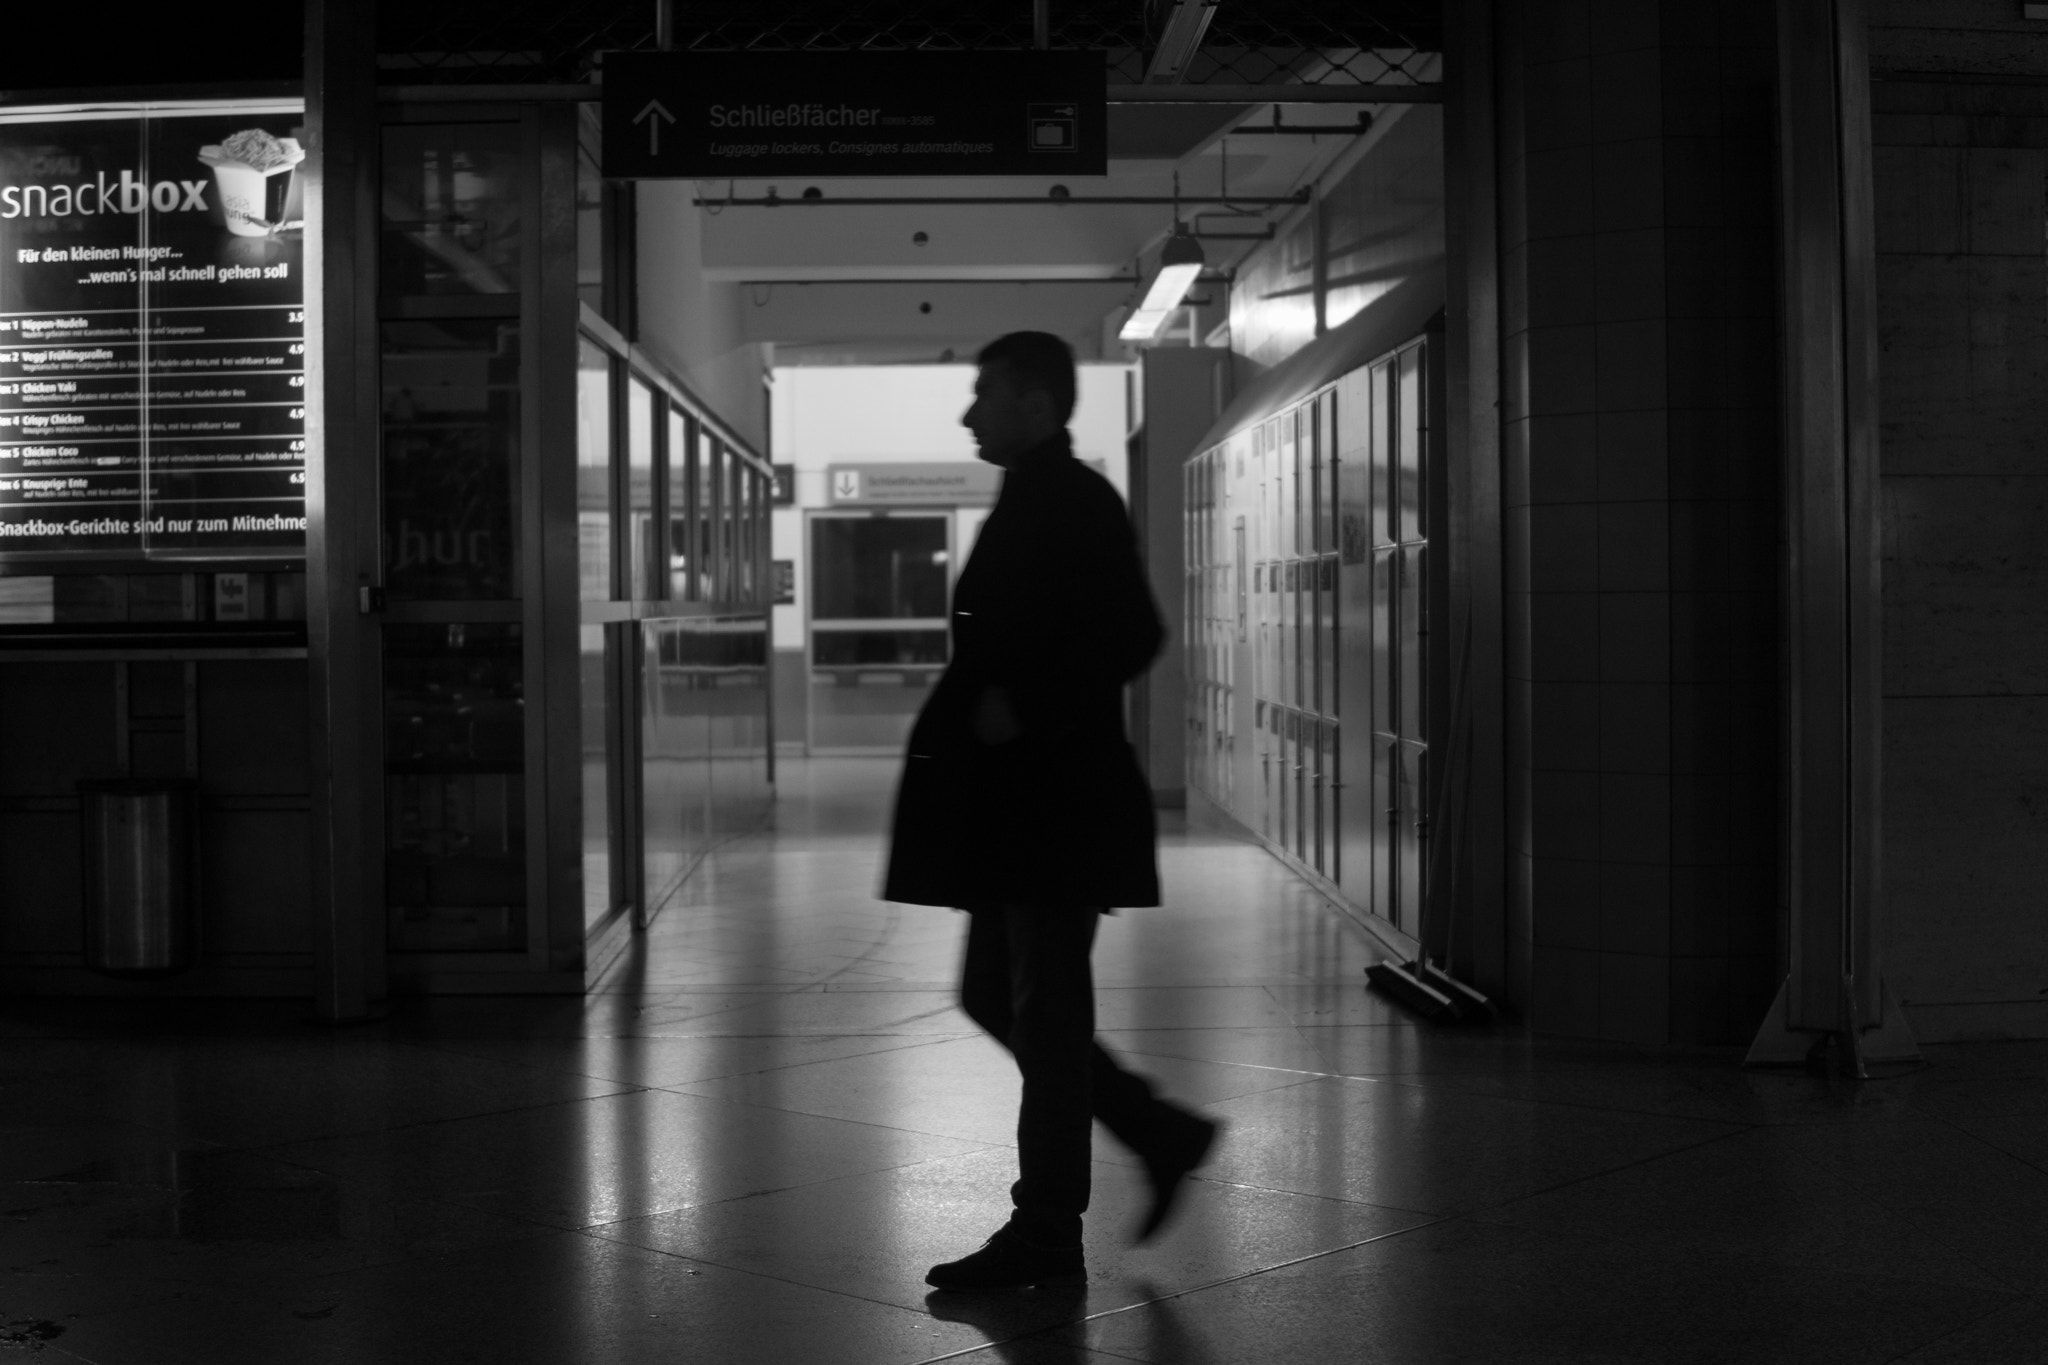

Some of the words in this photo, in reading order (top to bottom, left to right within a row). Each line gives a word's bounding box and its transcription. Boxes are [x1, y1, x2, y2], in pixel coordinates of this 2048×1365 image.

[709, 104, 881, 127] Schließfächer
[709, 141, 769, 158] Luggage
[771, 141, 824, 156] lockers,
[828, 141, 899, 157] Consignes
[902, 140, 994, 156] automatiques
[1, 169, 209, 219] snackbox
[18, 248, 40, 263] Für
[42, 247, 68, 262] den
[70, 246, 120, 261] kleinen
[140, 266, 166, 282] mal
[169, 264, 216, 282] schnell
[218, 264, 261, 284] gehen
[264, 262, 288, 279] soll
[22, 317, 88, 331] Nippon-Nudeln
[12, 351, 20, 363] 2
[22, 351, 48, 363] Veggi
[12, 384, 20, 394] 3
[22, 383, 56, 394] Chicken
[57, 382, 76, 392] Yaki
[12, 415, 20, 426] 4
[22, 415, 50, 427] Crispy
[50, 414, 84, 425] Chicken
[12, 447, 20, 458] 5
[22, 447, 57, 458] Chicken
[58, 446, 79, 457] Coco
[12, 479, 20, 490] 6
[23, 478, 68, 491] Knusprige
[68, 478, 88, 488] Ente
[0, 518, 130, 537] Snackbox-Gerichte
[133, 517, 164, 533] sind
[168, 519, 194, 533] nur
[196, 518, 229, 533] zum
